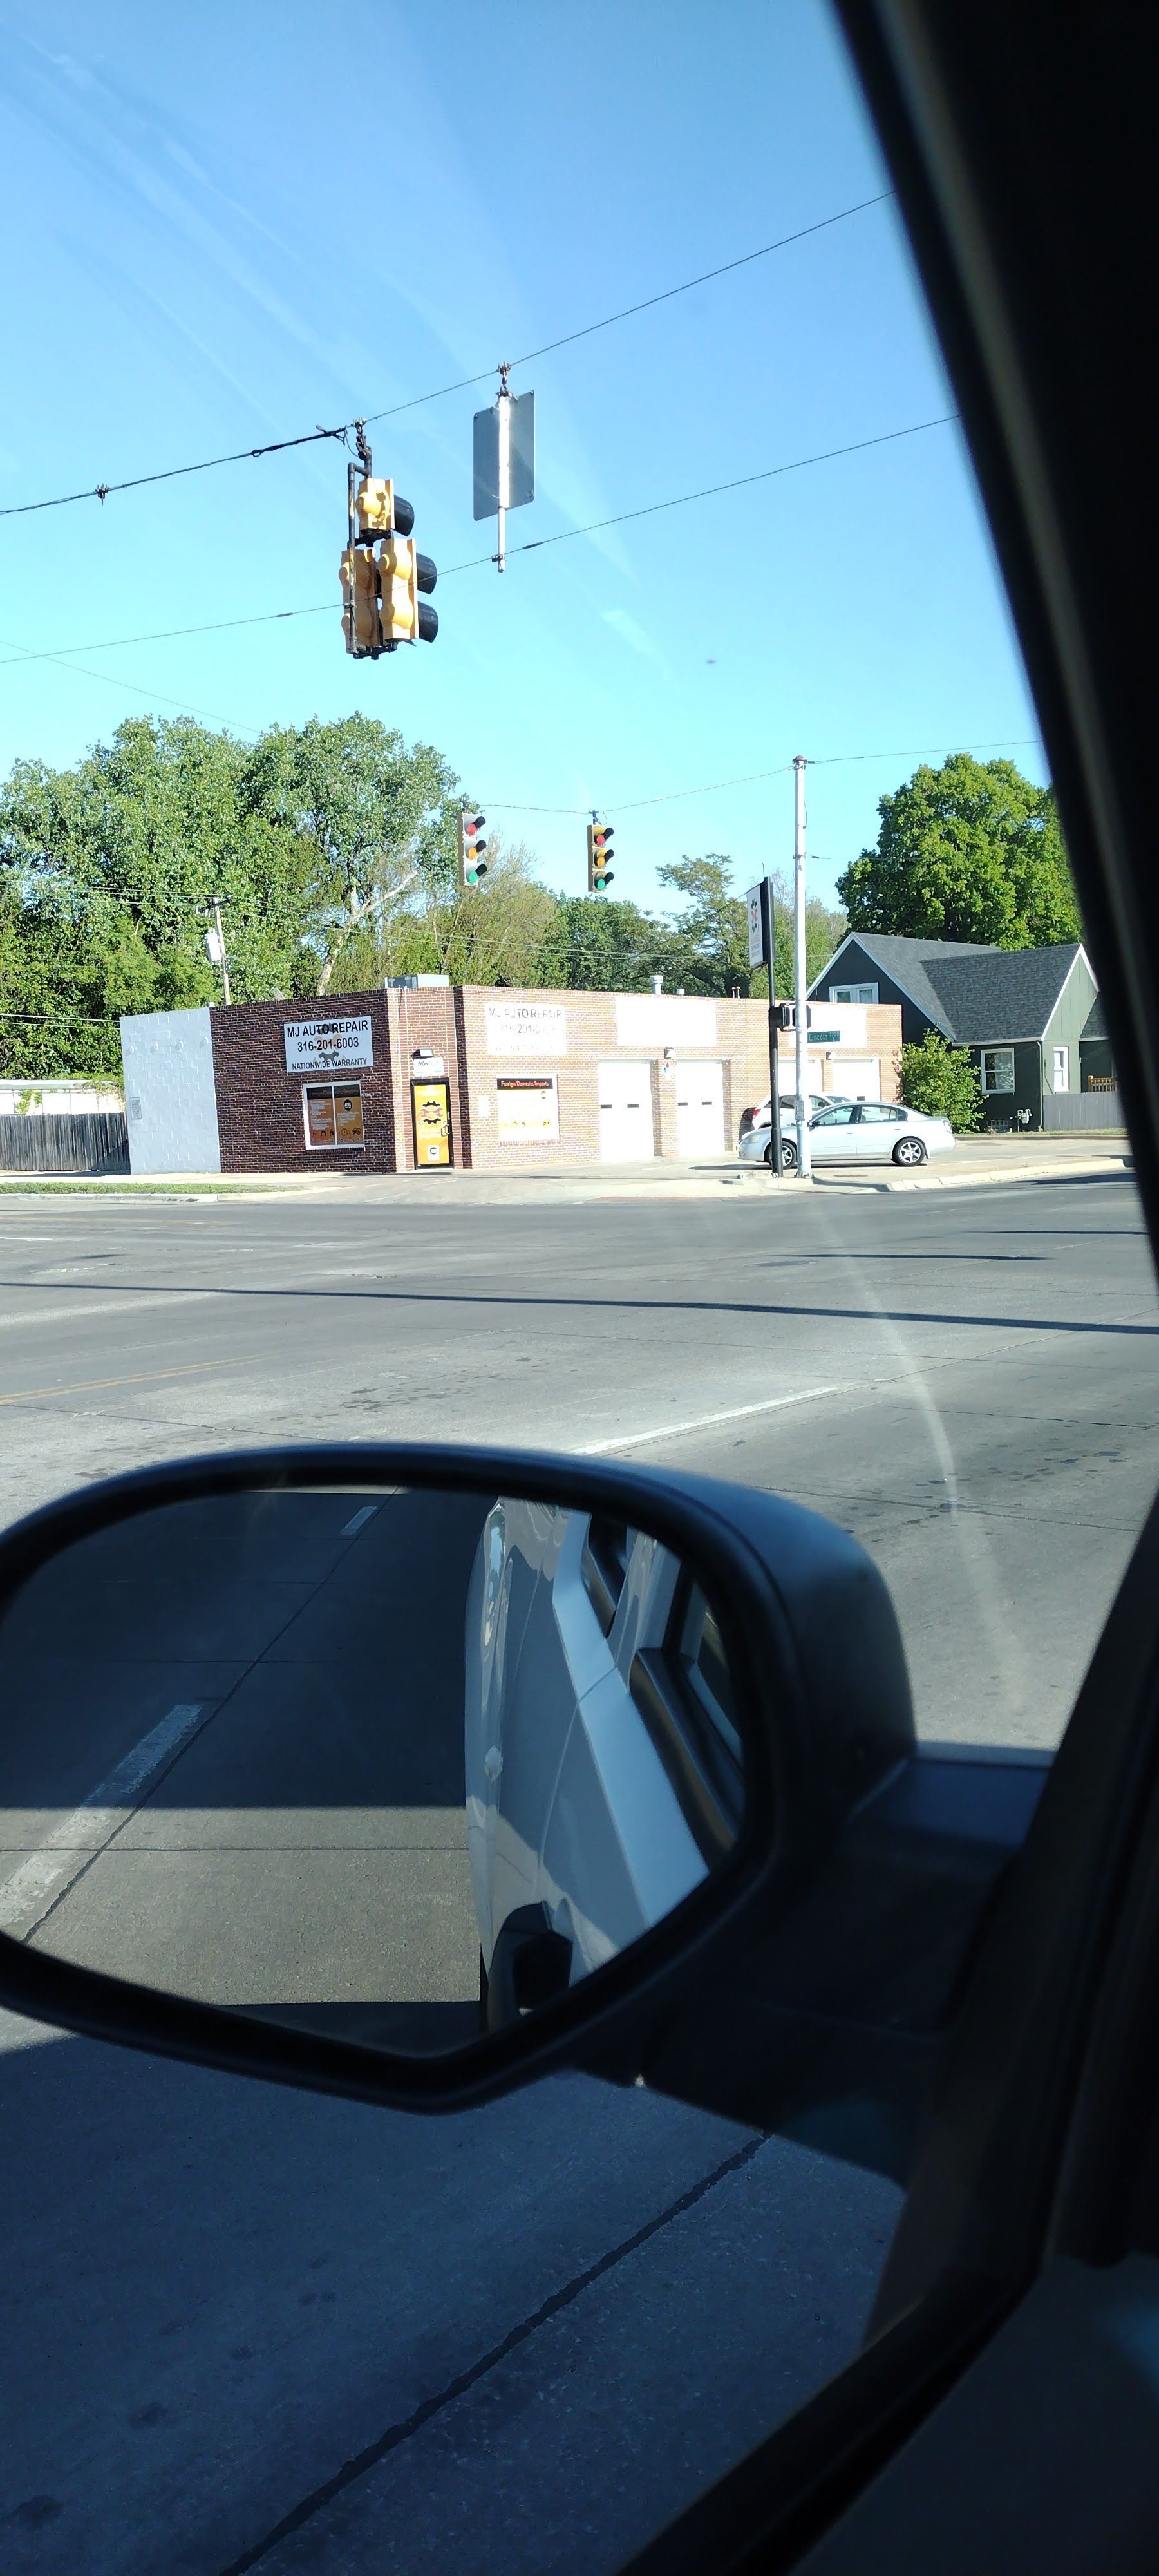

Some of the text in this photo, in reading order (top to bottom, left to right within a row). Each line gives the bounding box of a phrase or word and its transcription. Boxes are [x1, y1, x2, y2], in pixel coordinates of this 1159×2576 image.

[287, 1020, 368, 1037] MJ AUTO REPAIR
[297, 1037, 359, 1052] 316-201-6003
[292, 1057, 367, 1070] NATIONWIDE WARRANTY
